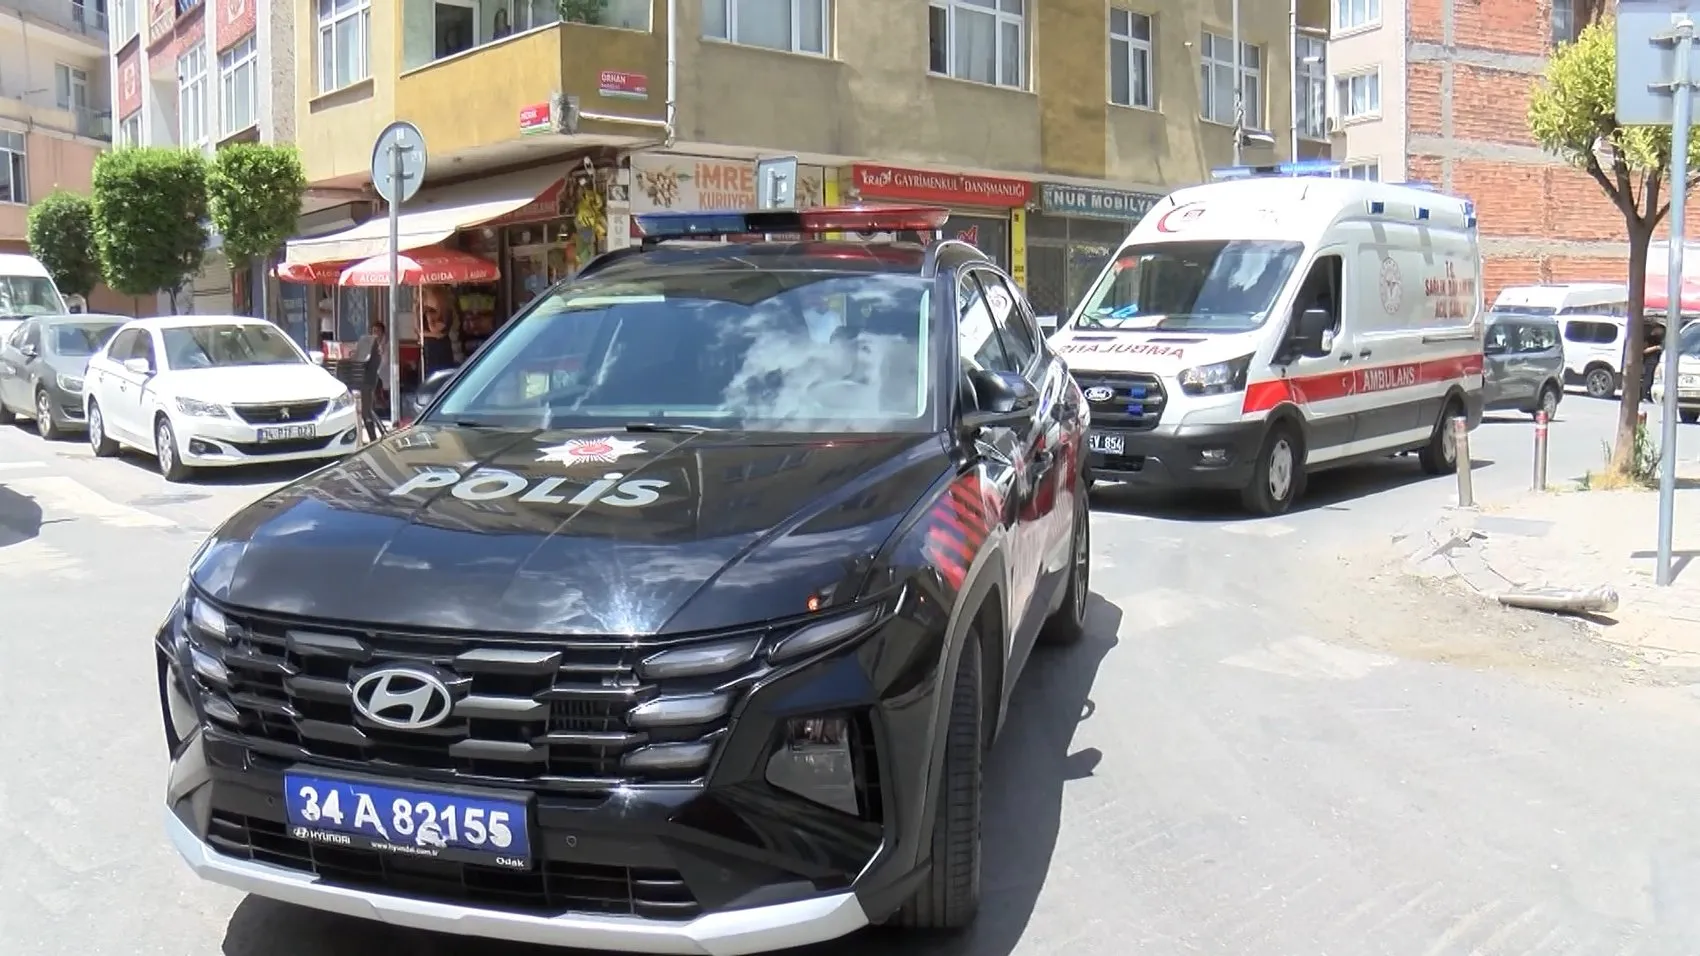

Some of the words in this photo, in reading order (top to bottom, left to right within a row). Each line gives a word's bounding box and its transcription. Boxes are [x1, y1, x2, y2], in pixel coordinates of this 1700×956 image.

[601, 72, 626, 84] ORHAN
[894, 173, 958, 191] GAYRİMENKUL
[964, 180, 1025, 198] DANIŞMANLIĞI
[700, 191, 756, 210] KURUYEM
[1053, 190, 1086, 207] NUR
[1091, 193, 1154, 213] MOBİLYA
[420, 272, 454, 283] ALGIDA
[1363, 366, 1415, 391] AMBULANS
[1104, 436, 1122, 451] 854
[299, 786, 344, 825] 34
[354, 793, 390, 840] A
[310, 830, 351, 845] HYUNDAI
[496, 857, 524, 867] Odak
